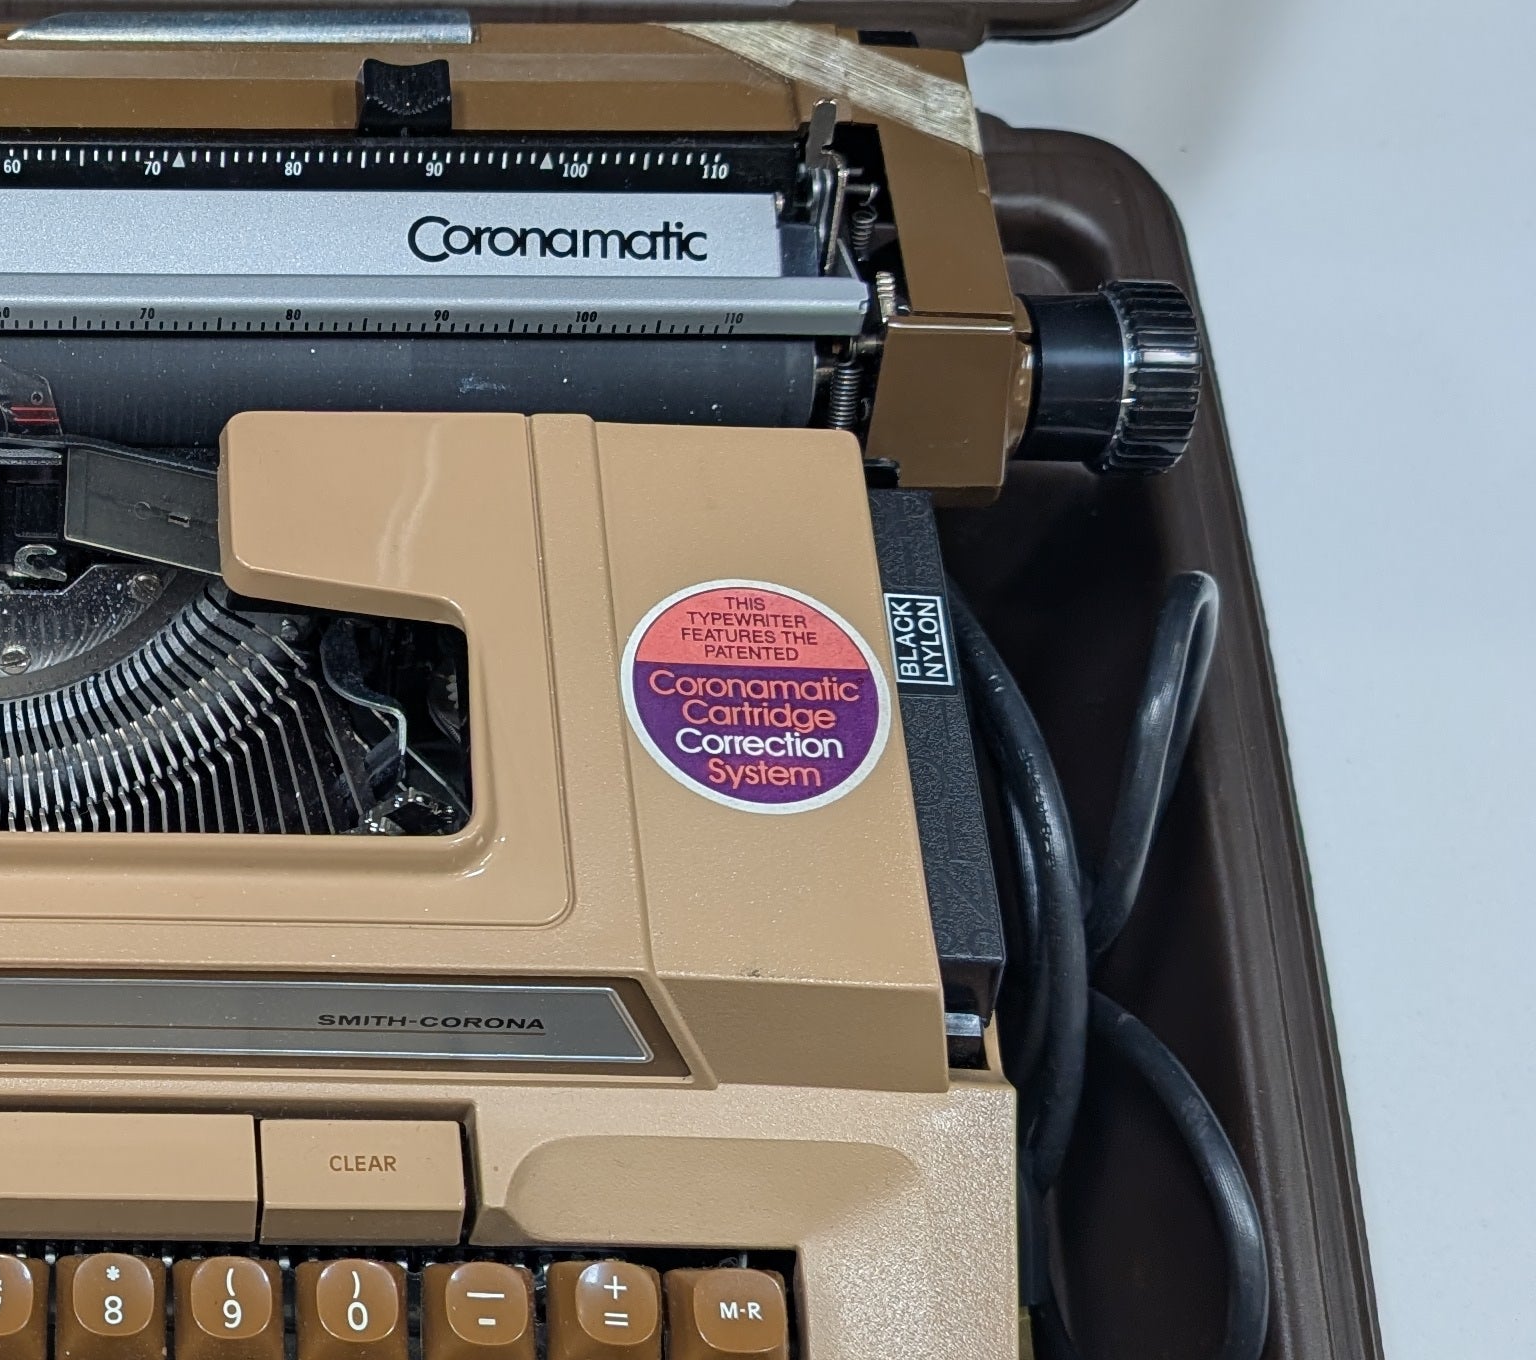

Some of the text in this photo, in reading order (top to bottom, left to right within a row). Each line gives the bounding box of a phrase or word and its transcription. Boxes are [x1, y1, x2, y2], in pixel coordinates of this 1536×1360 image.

[3, 160, 21, 174] 60
[144, 161, 161, 176] 70
[284, 162, 302, 176] 80
[425, 162, 443, 177] 90
[562, 163, 588, 179] 100
[702, 163, 729, 180] 110
[408, 216, 708, 262] Coronamatic
[140, 308, 155, 320] 70
[286, 309, 301, 321] 80
[434, 310, 450, 322] 90
[575, 311, 598, 323] 100
[724, 312, 744, 324] 110
[724, 597, 765, 611] THIS
[686, 611, 807, 629] TYPEWRITER
[681, 628, 817, 645] FEATURES THE
[891, 600, 920, 677] BLACK
[916, 602, 945, 678] NYLON
[704, 644, 799, 661] PATENTED
[648, 669, 860, 702] Coronamatic
[682, 699, 836, 733] Cartridge
[676, 727, 844, 759] Correction
[708, 759, 821, 789] System
[317, 1014, 545, 1030] SMITH-CORONA
[329, 1155, 397, 1173] CLEAR
[226, 1267, 236, 1297] (
[351, 1270, 360, 1299] )
[604, 1275, 627, 1300] +
[104, 1295, 123, 1325] 8
[223, 1299, 242, 1329] 9
[604, 1312, 629, 1326] =
[719, 1302, 762, 1320] M-R
